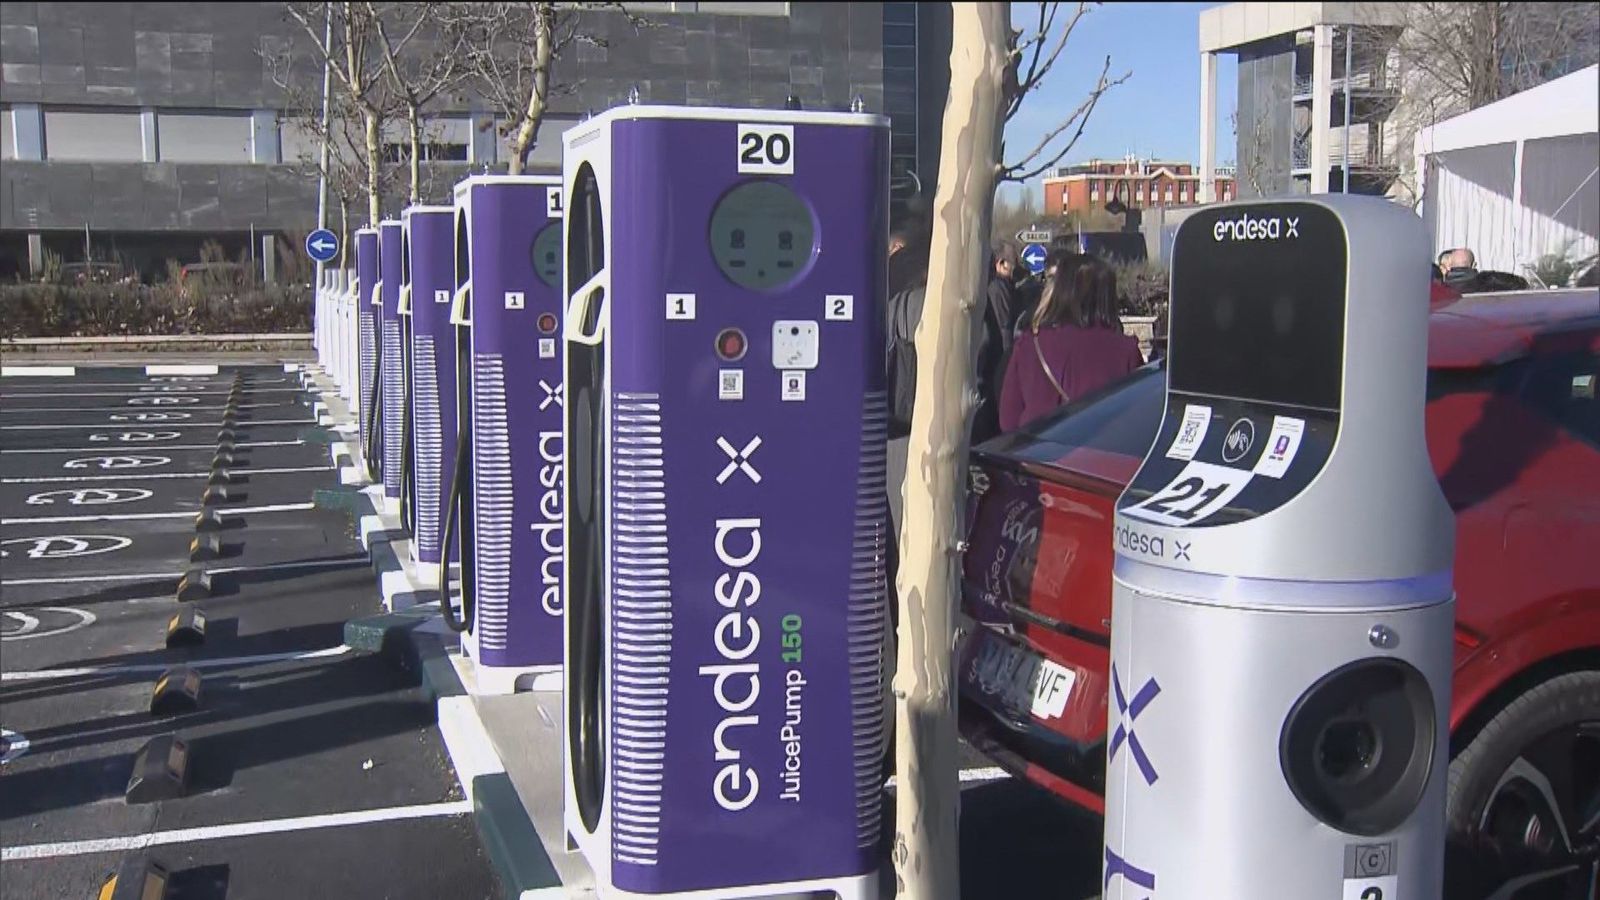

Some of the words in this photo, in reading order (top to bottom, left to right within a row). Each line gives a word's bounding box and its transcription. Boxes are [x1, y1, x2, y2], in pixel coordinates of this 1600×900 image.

[740, 132, 791, 165] 20
[551, 192, 562, 211] 1
[1213, 213, 1280, 241] endesa
[510, 296, 518, 306] 1
[675, 298, 686, 314] 1
[833, 299, 845, 315] 2
[1140, 477, 1230, 520] 21
[531, 431, 563, 616] endesa
[1115, 525, 1164, 557] ndesa
[782, 614, 802, 662] 150
[699, 518, 761, 811] endesa
[780, 669, 807, 801] JuicePump
[1368, 853, 1379, 868] C
